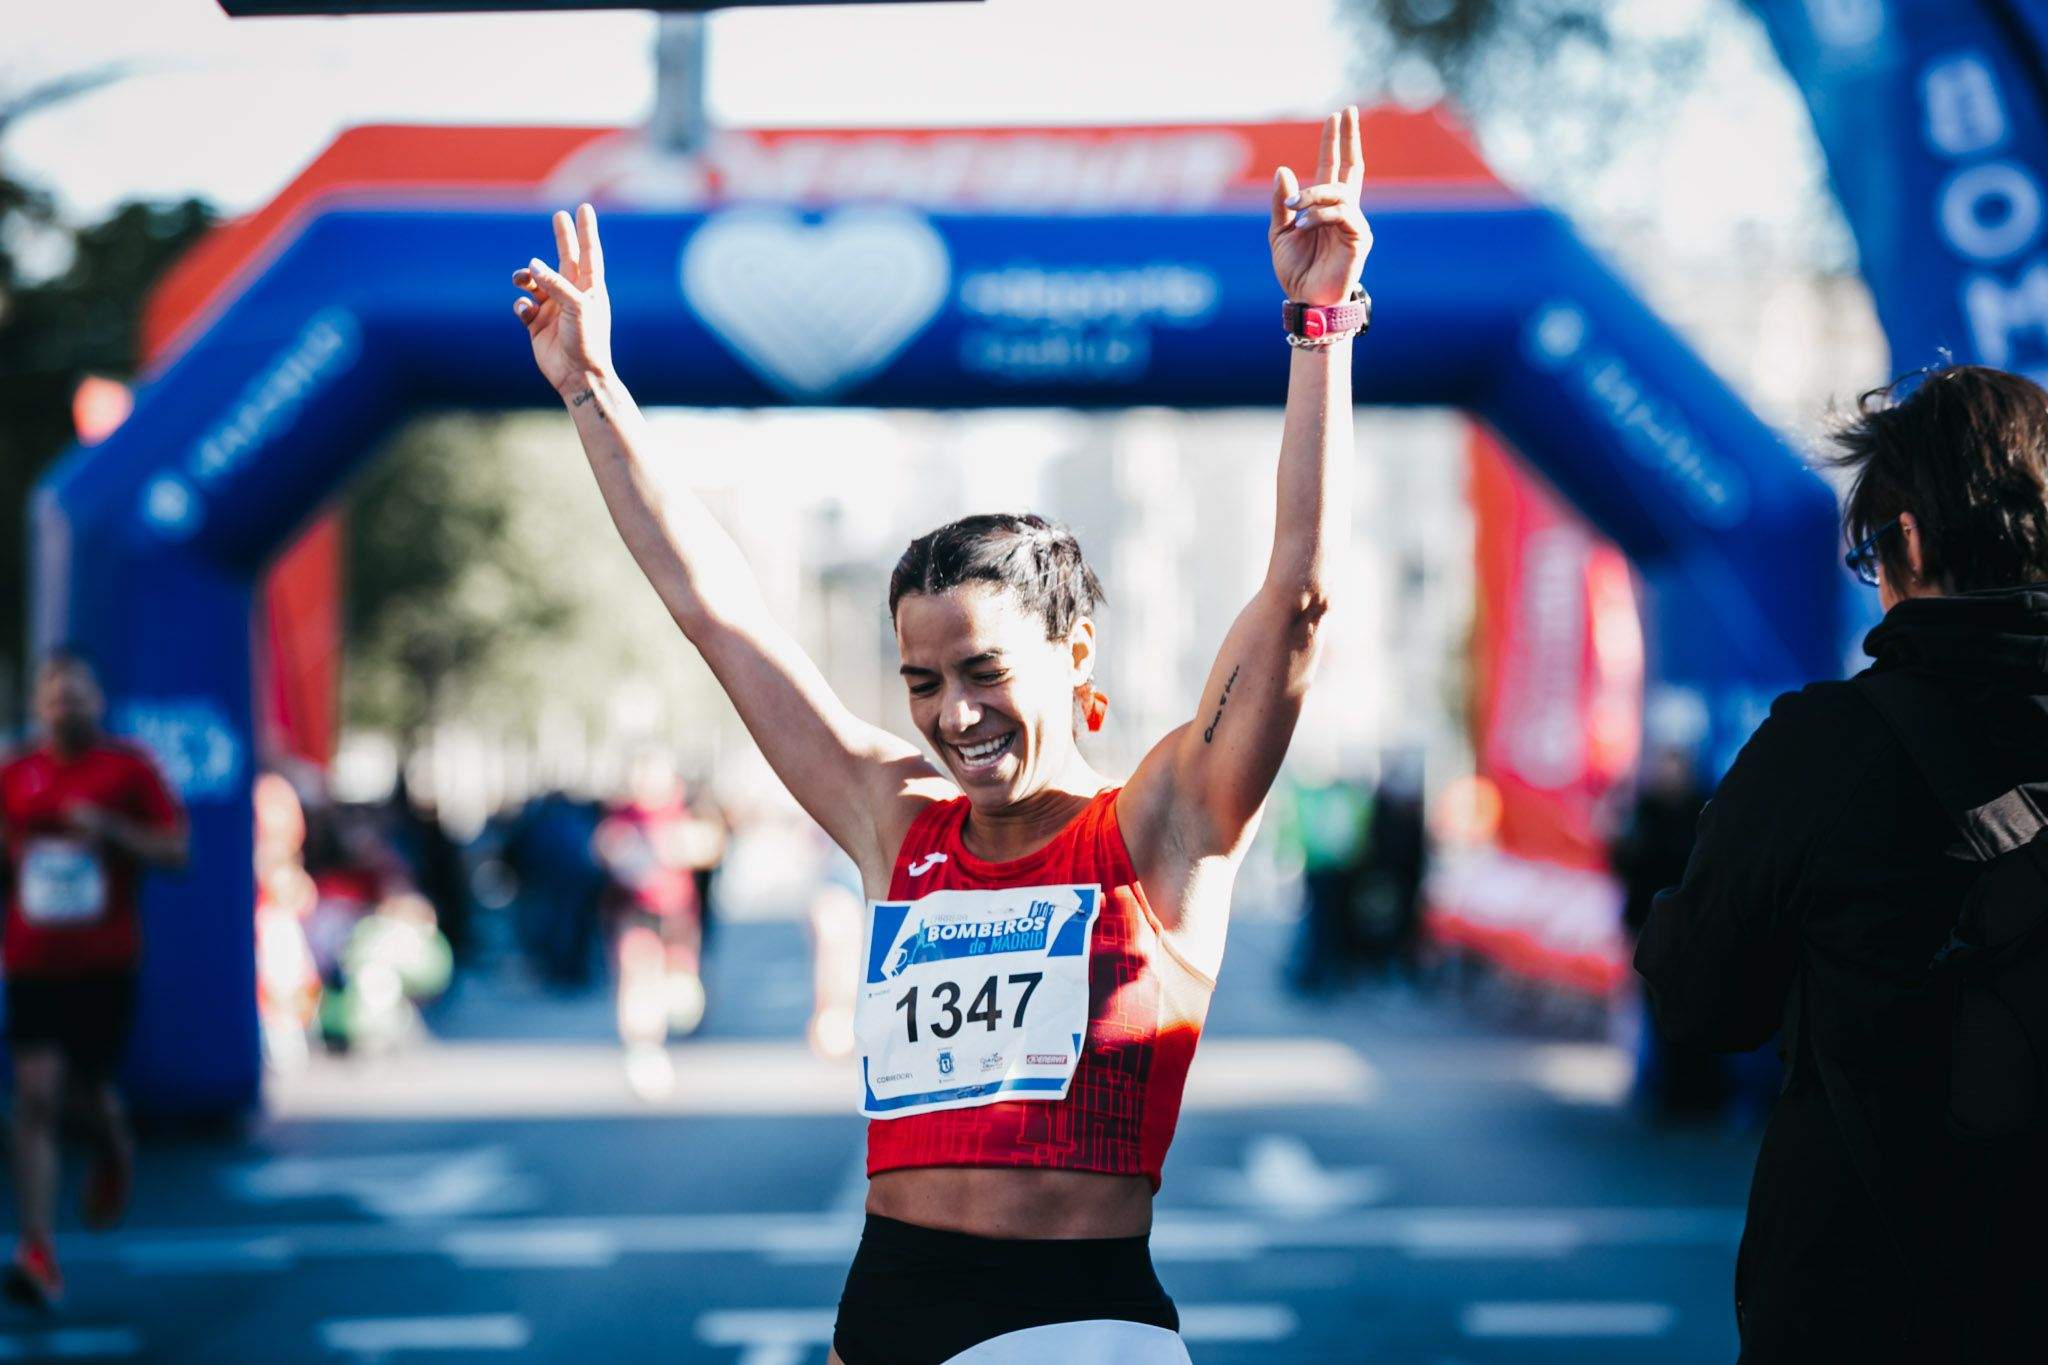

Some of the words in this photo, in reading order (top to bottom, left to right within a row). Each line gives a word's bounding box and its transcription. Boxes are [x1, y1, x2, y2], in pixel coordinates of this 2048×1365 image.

[1924, 56, 2048, 384] BOM
[927, 916, 1047, 942] BOMBEROS
[969, 938, 986, 954] de
[990, 931, 1044, 953] MADRID
[896, 972, 1043, 1043] 1347
